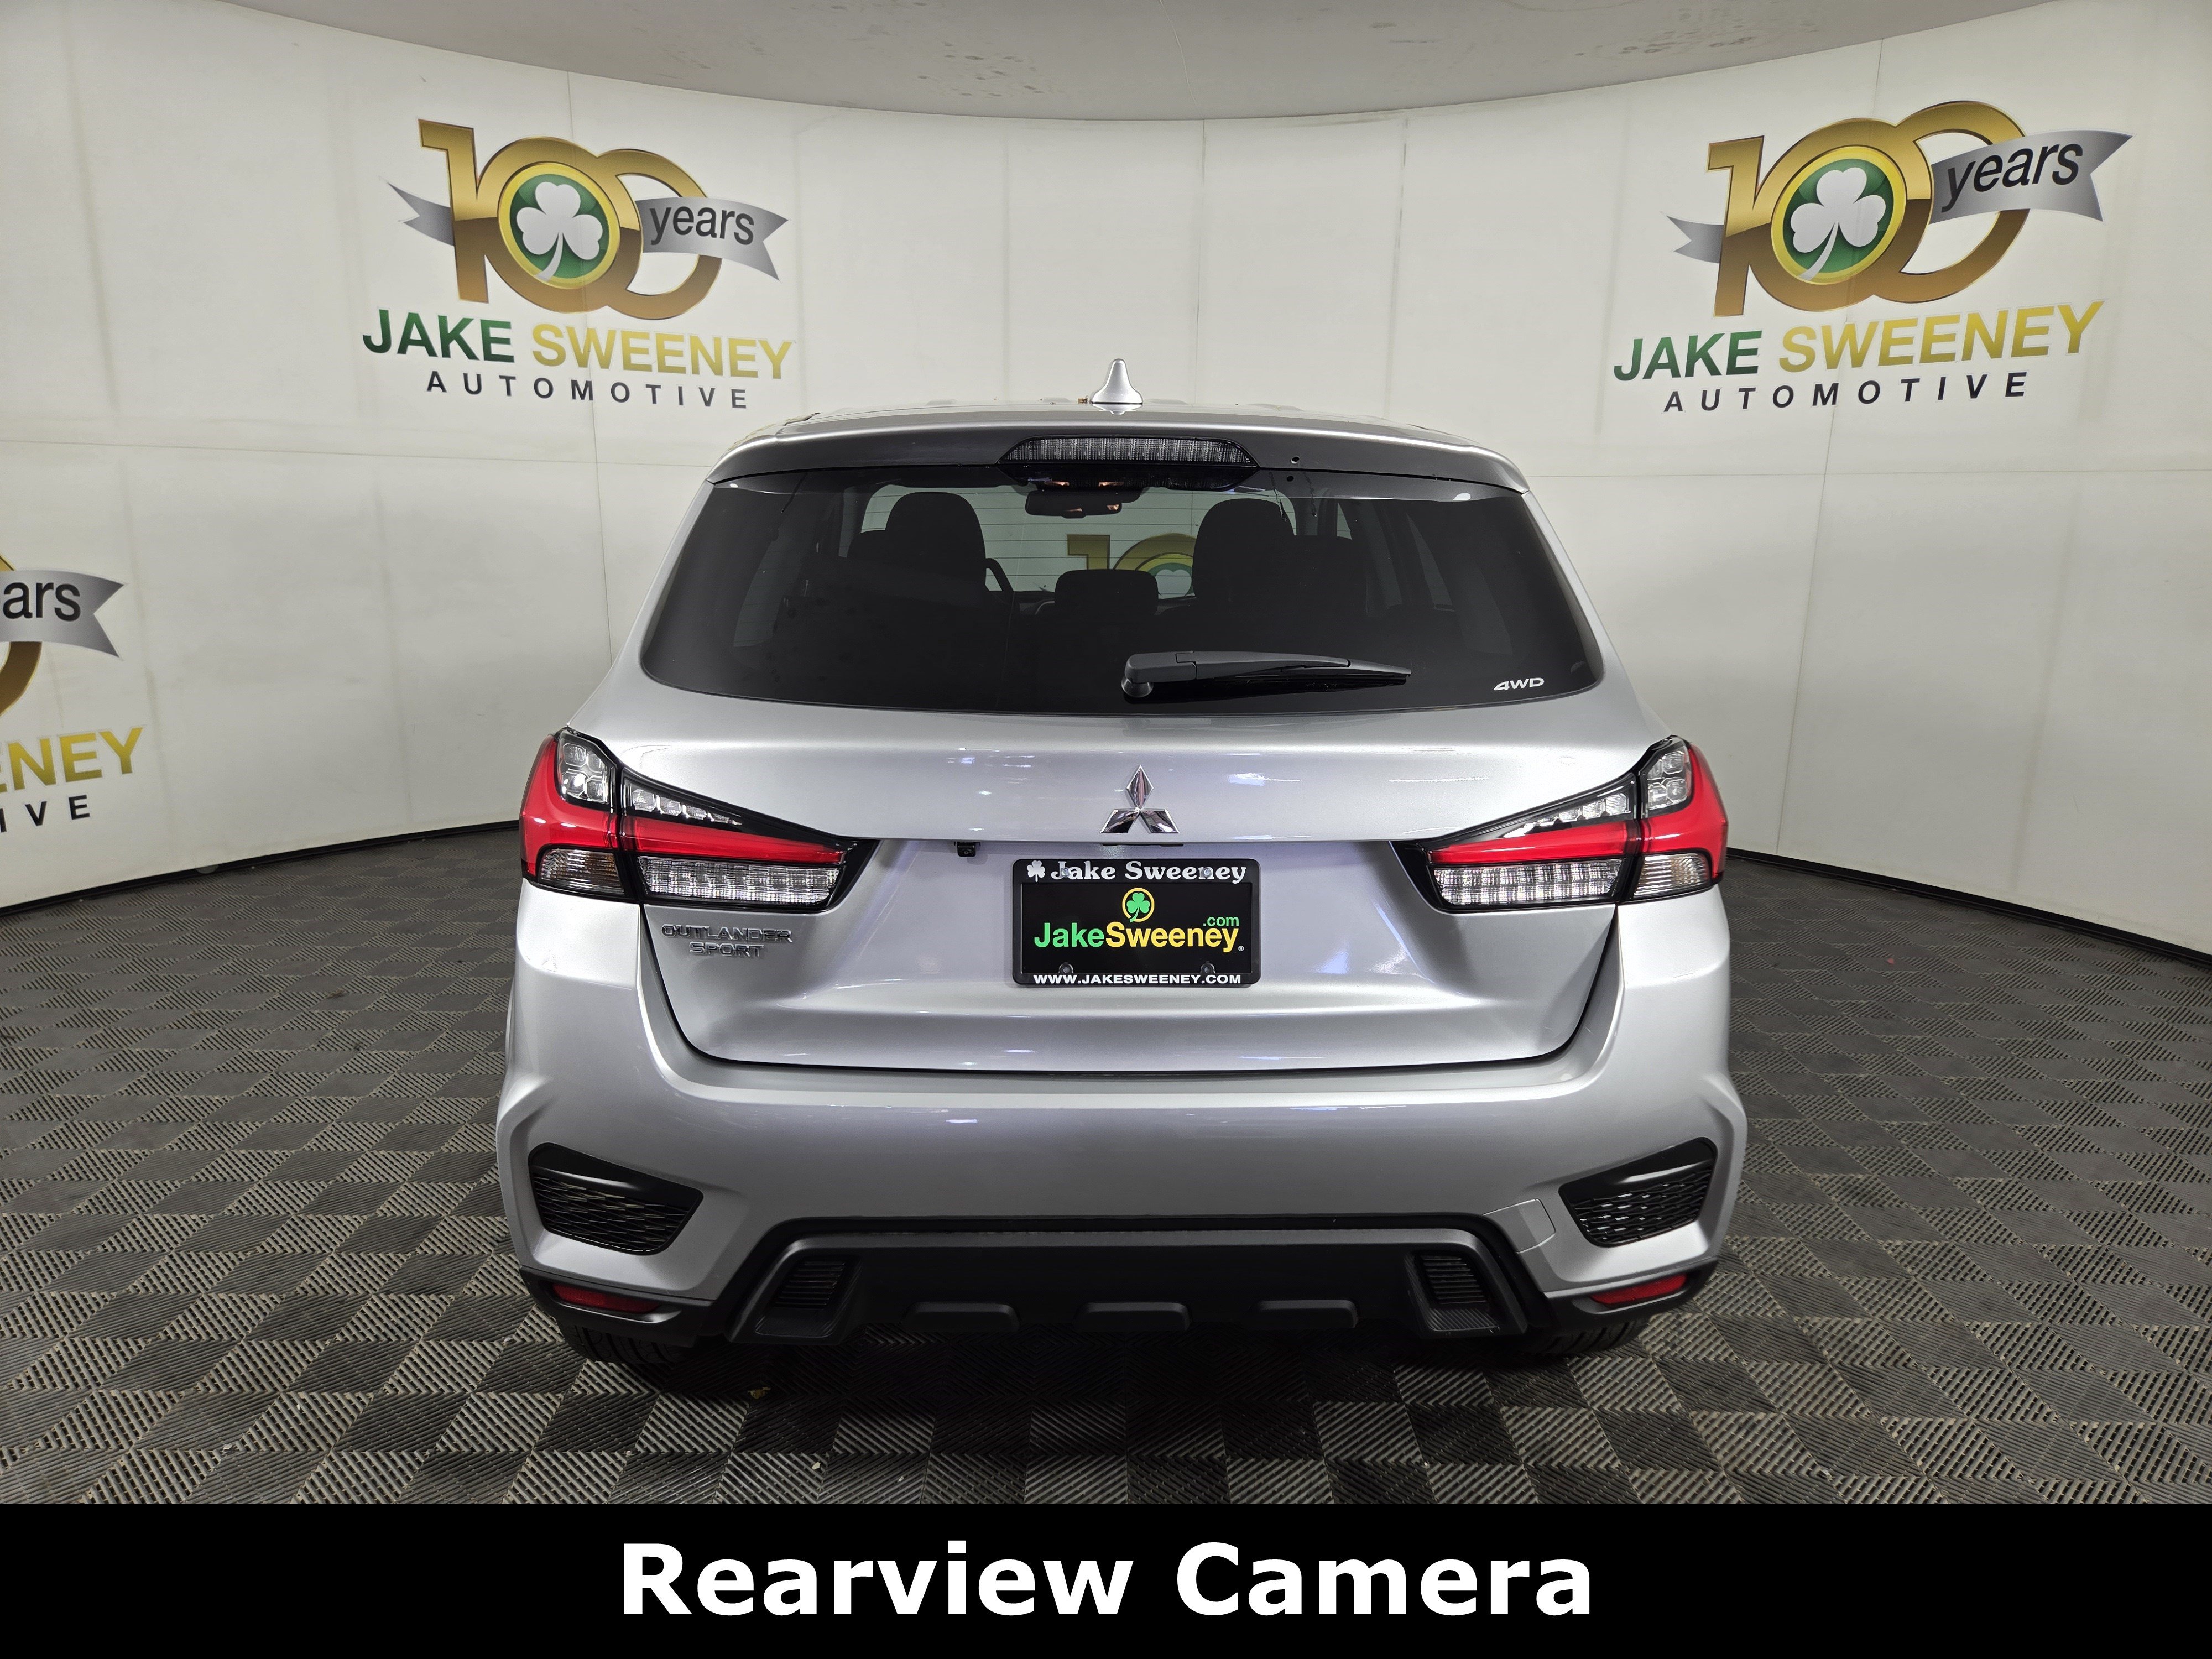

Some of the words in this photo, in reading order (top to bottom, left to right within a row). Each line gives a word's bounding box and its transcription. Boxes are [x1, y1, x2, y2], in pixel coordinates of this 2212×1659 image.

[418, 119, 723, 320] 100
[649, 205, 754, 246] years
[1707, 100, 2030, 317] 100
[1940, 142, 2083, 213] years
[362, 309, 515, 363] JAKE
[532, 324, 791, 379] SWEENEY
[1614, 331, 1762, 381] JAKE
[1778, 300, 2104, 373] SWEENEY
[427, 371, 746, 409] AUTOMOTIVE
[1663, 372, 2027, 413] AUTOMOTIVE
[2, 582, 81, 622] ars
[1494, 677, 1545, 691] 4WD
[1051, 860, 1116, 881] Jake
[1124, 860, 1246, 884] Sweeney
[661, 924, 792, 943] OUTLANDER
[689, 941, 765, 957] SPORT
[1033, 974, 1241, 984] WWW.JAKESWEENEY.COM
